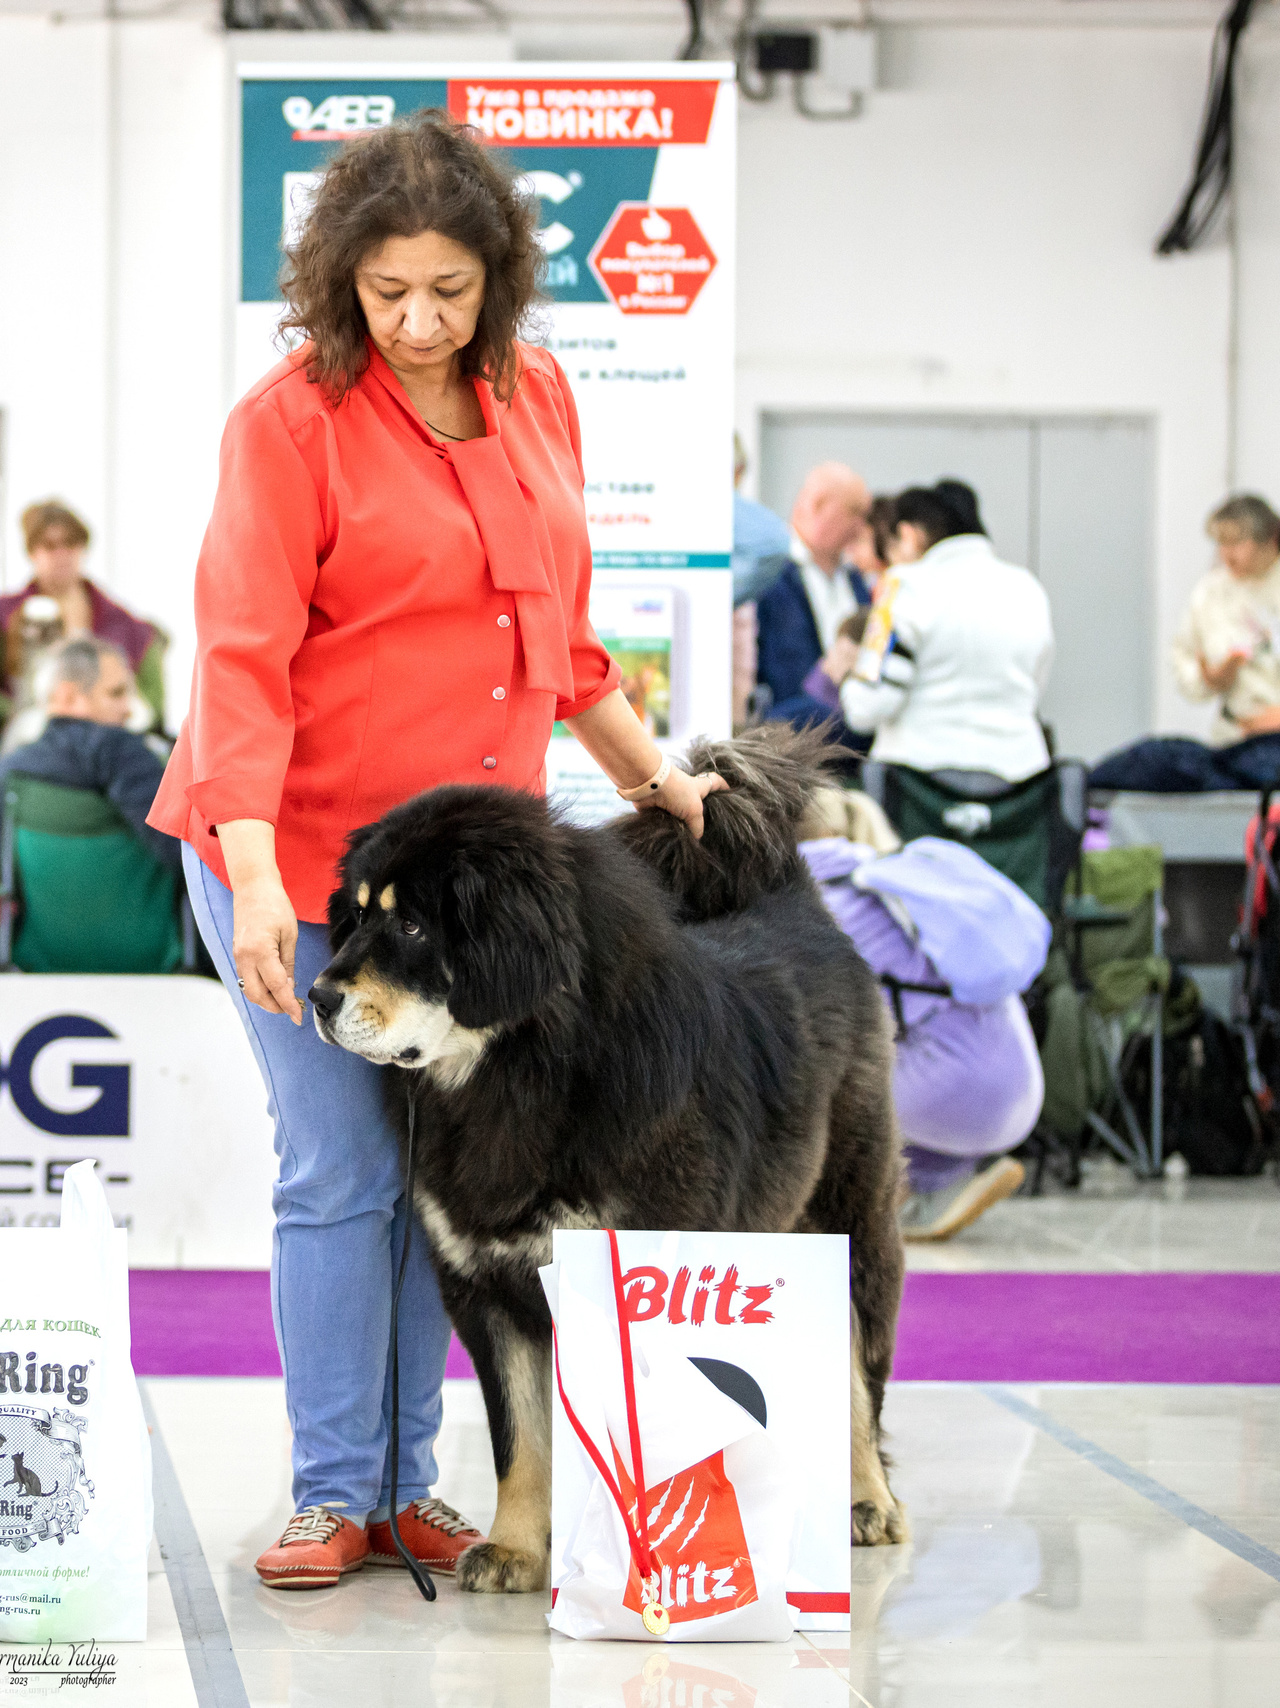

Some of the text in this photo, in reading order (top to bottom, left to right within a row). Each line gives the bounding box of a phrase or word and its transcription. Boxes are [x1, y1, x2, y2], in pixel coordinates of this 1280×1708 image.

[467, 107, 674, 139] НОВИНКА!
[0, 1319, 36, 1333] ДЛЯ
[43, 1319, 102, 1339] КОШЕК
[2, 1526, 29, 1536] FOOD
[52, 1565, 90, 1581] форме!
